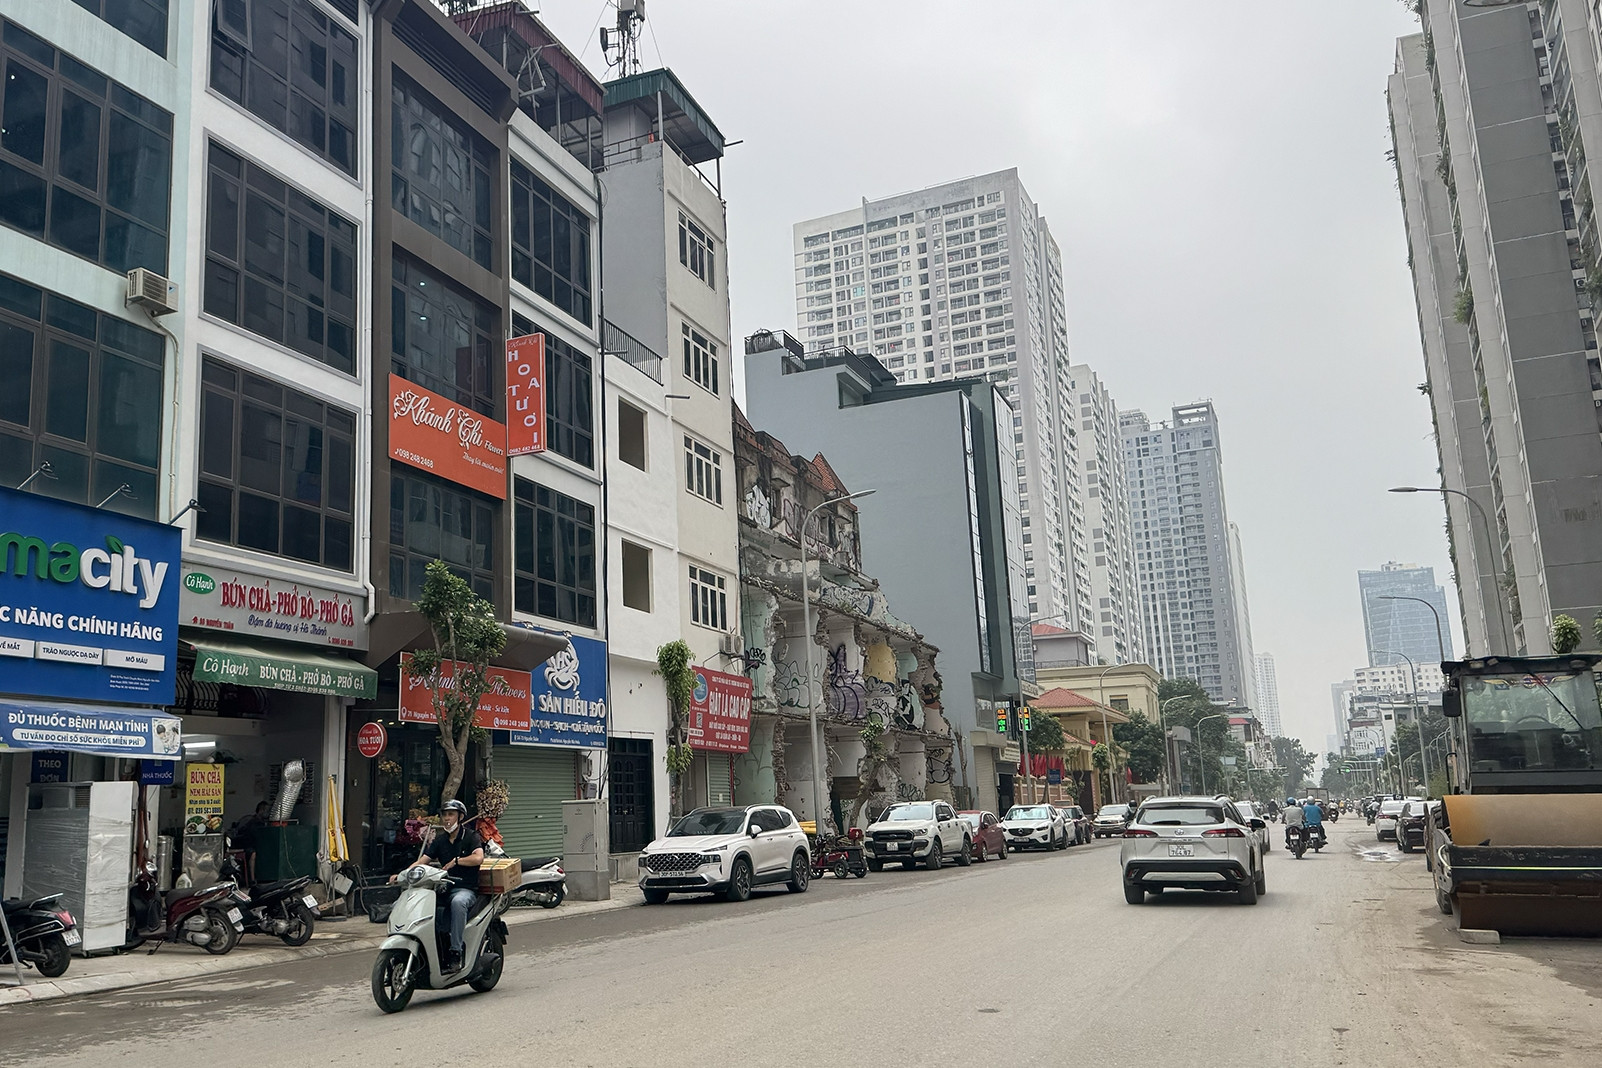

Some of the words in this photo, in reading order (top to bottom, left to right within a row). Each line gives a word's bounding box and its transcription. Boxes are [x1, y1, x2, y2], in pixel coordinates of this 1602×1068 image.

[393, 390, 455, 433] Khánh
[457, 409, 483, 450] Chi
[186, 575, 195, 587] Cô
[195, 577, 213, 591] Hạnh
[220, 577, 247, 608] BÚN
[341, 598, 355, 627] GÀ
[15, 606, 63, 629] NĂNG
[68, 612, 117, 636] CHÍNH
[120, 621, 163, 641] HÃNG
[203, 657, 218, 673] Cô
[221, 658, 249, 677] Hạnh
[260, 663, 278, 680] BÚN
[279, 664, 296, 683] CHẢ
[302, 667, 319, 685] PHỞ
[321, 670, 332, 687] BÒ
[337, 672, 353, 689] PHỞ
[353, 675, 364, 690] GÀ
[538, 690, 562, 714] SẢN
[588, 697, 606, 718] ĐÔ
[709, 687, 721, 720] GIẶT
[721, 689, 728, 717] LÀ
[729, 694, 739, 719] CAO
[740, 690, 750, 720] CẤP
[8, 710, 25, 724] ĐỦ
[27, 712, 66, 728] THUỐC
[68, 716, 97, 731] BỆNH
[99, 720, 124, 733] MẠN
[124, 720, 149, 733] TÍNH
[38, 759, 62, 768] THEO
[154, 771, 173, 779] THUỐC
[190, 768, 205, 784] BÚN
